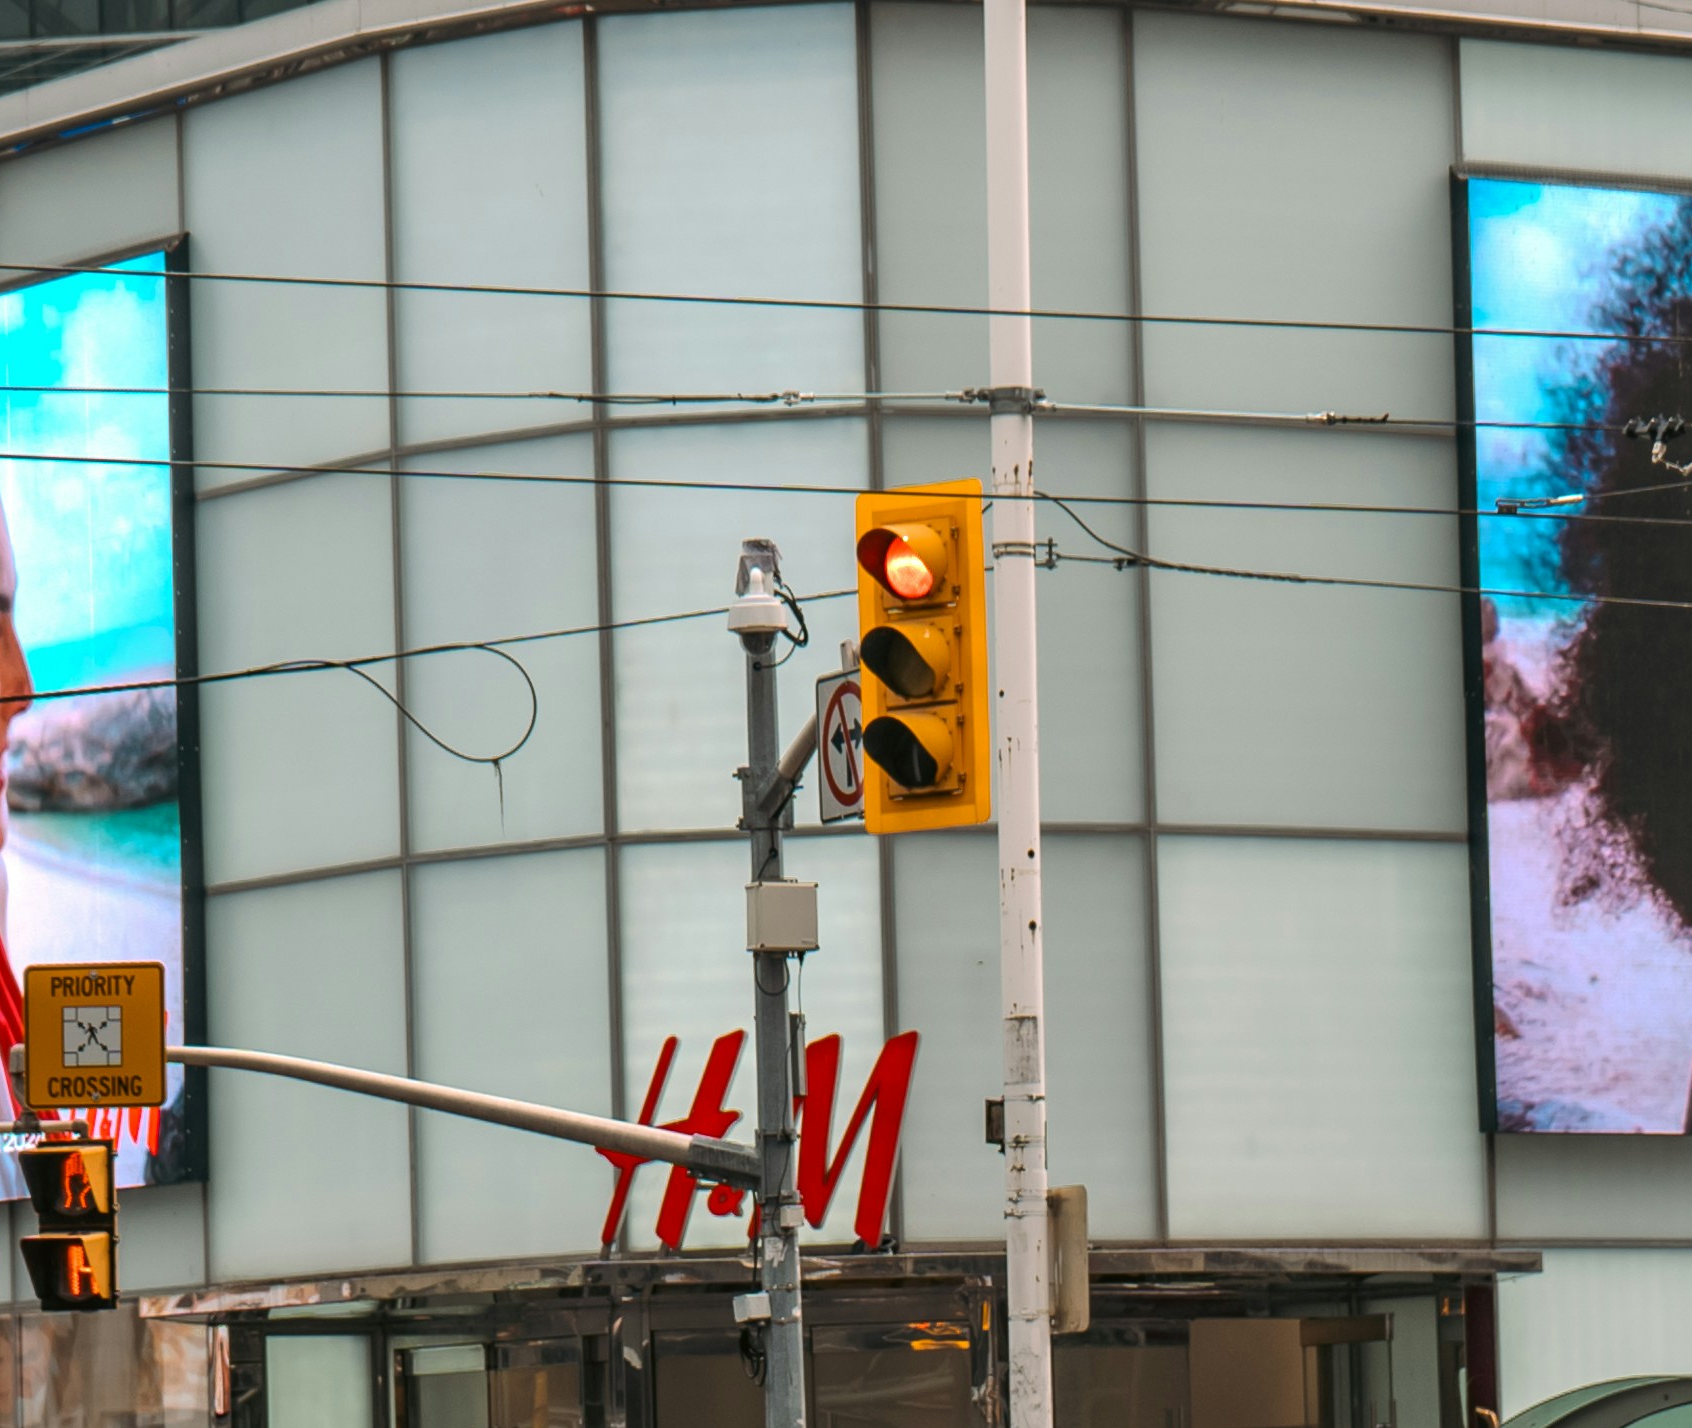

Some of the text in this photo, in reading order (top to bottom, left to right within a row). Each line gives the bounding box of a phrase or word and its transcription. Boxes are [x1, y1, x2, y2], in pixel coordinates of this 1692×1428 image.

[50, 975, 136, 998] PRIORITY
[47, 1075, 143, 1100] CROSSING
[594, 1028, 920, 1251] H&M
